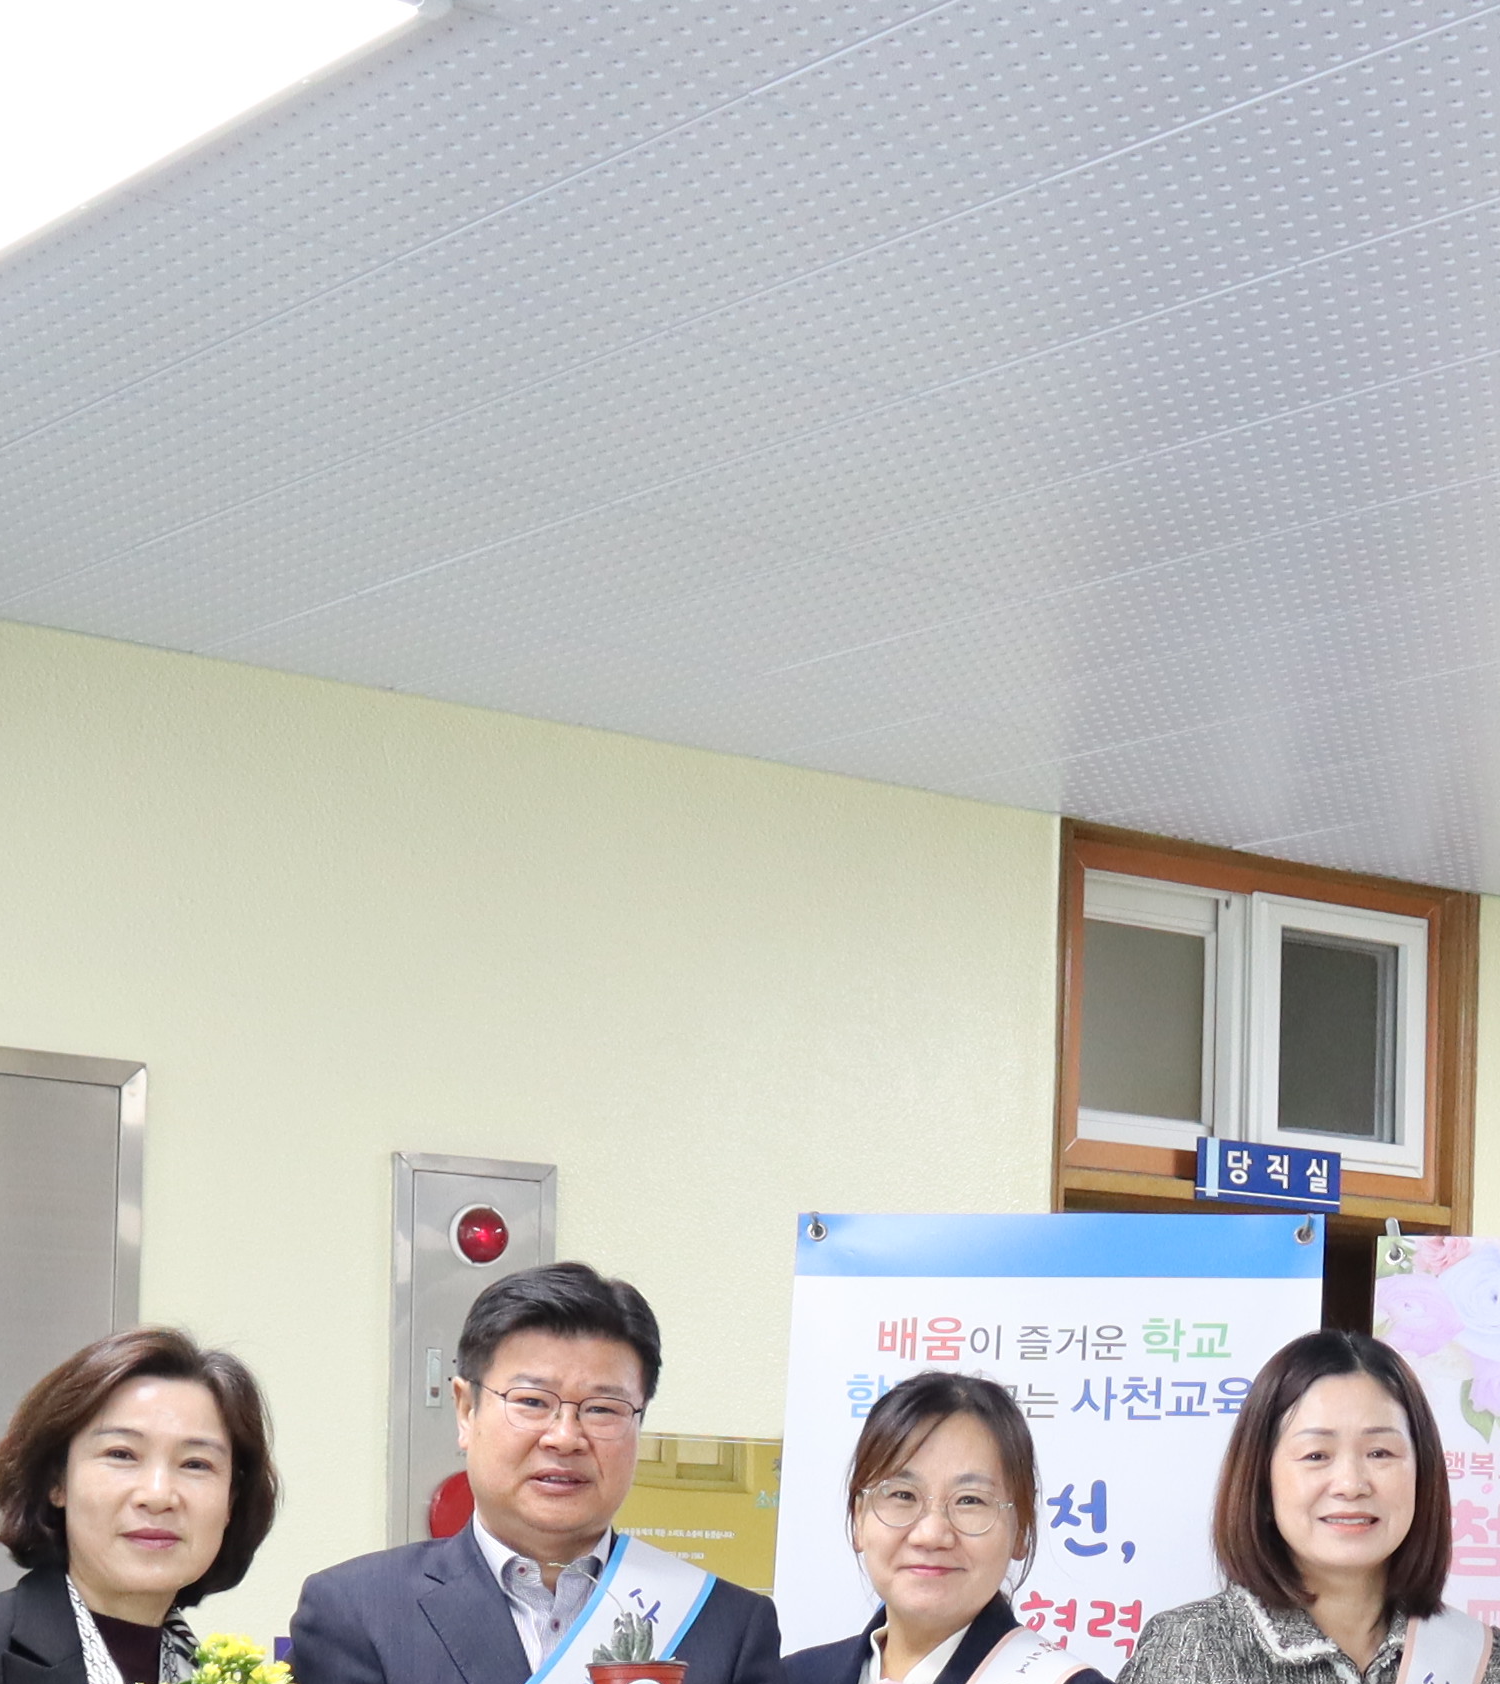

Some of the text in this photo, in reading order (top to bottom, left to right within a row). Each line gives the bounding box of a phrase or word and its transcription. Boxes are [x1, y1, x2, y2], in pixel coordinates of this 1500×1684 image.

[1225, 1149, 1330, 1194] 당직실
[877, 1316, 1233, 1362] 배움이 즐거운 학교
[1046, 1479, 1136, 1564] 천,
